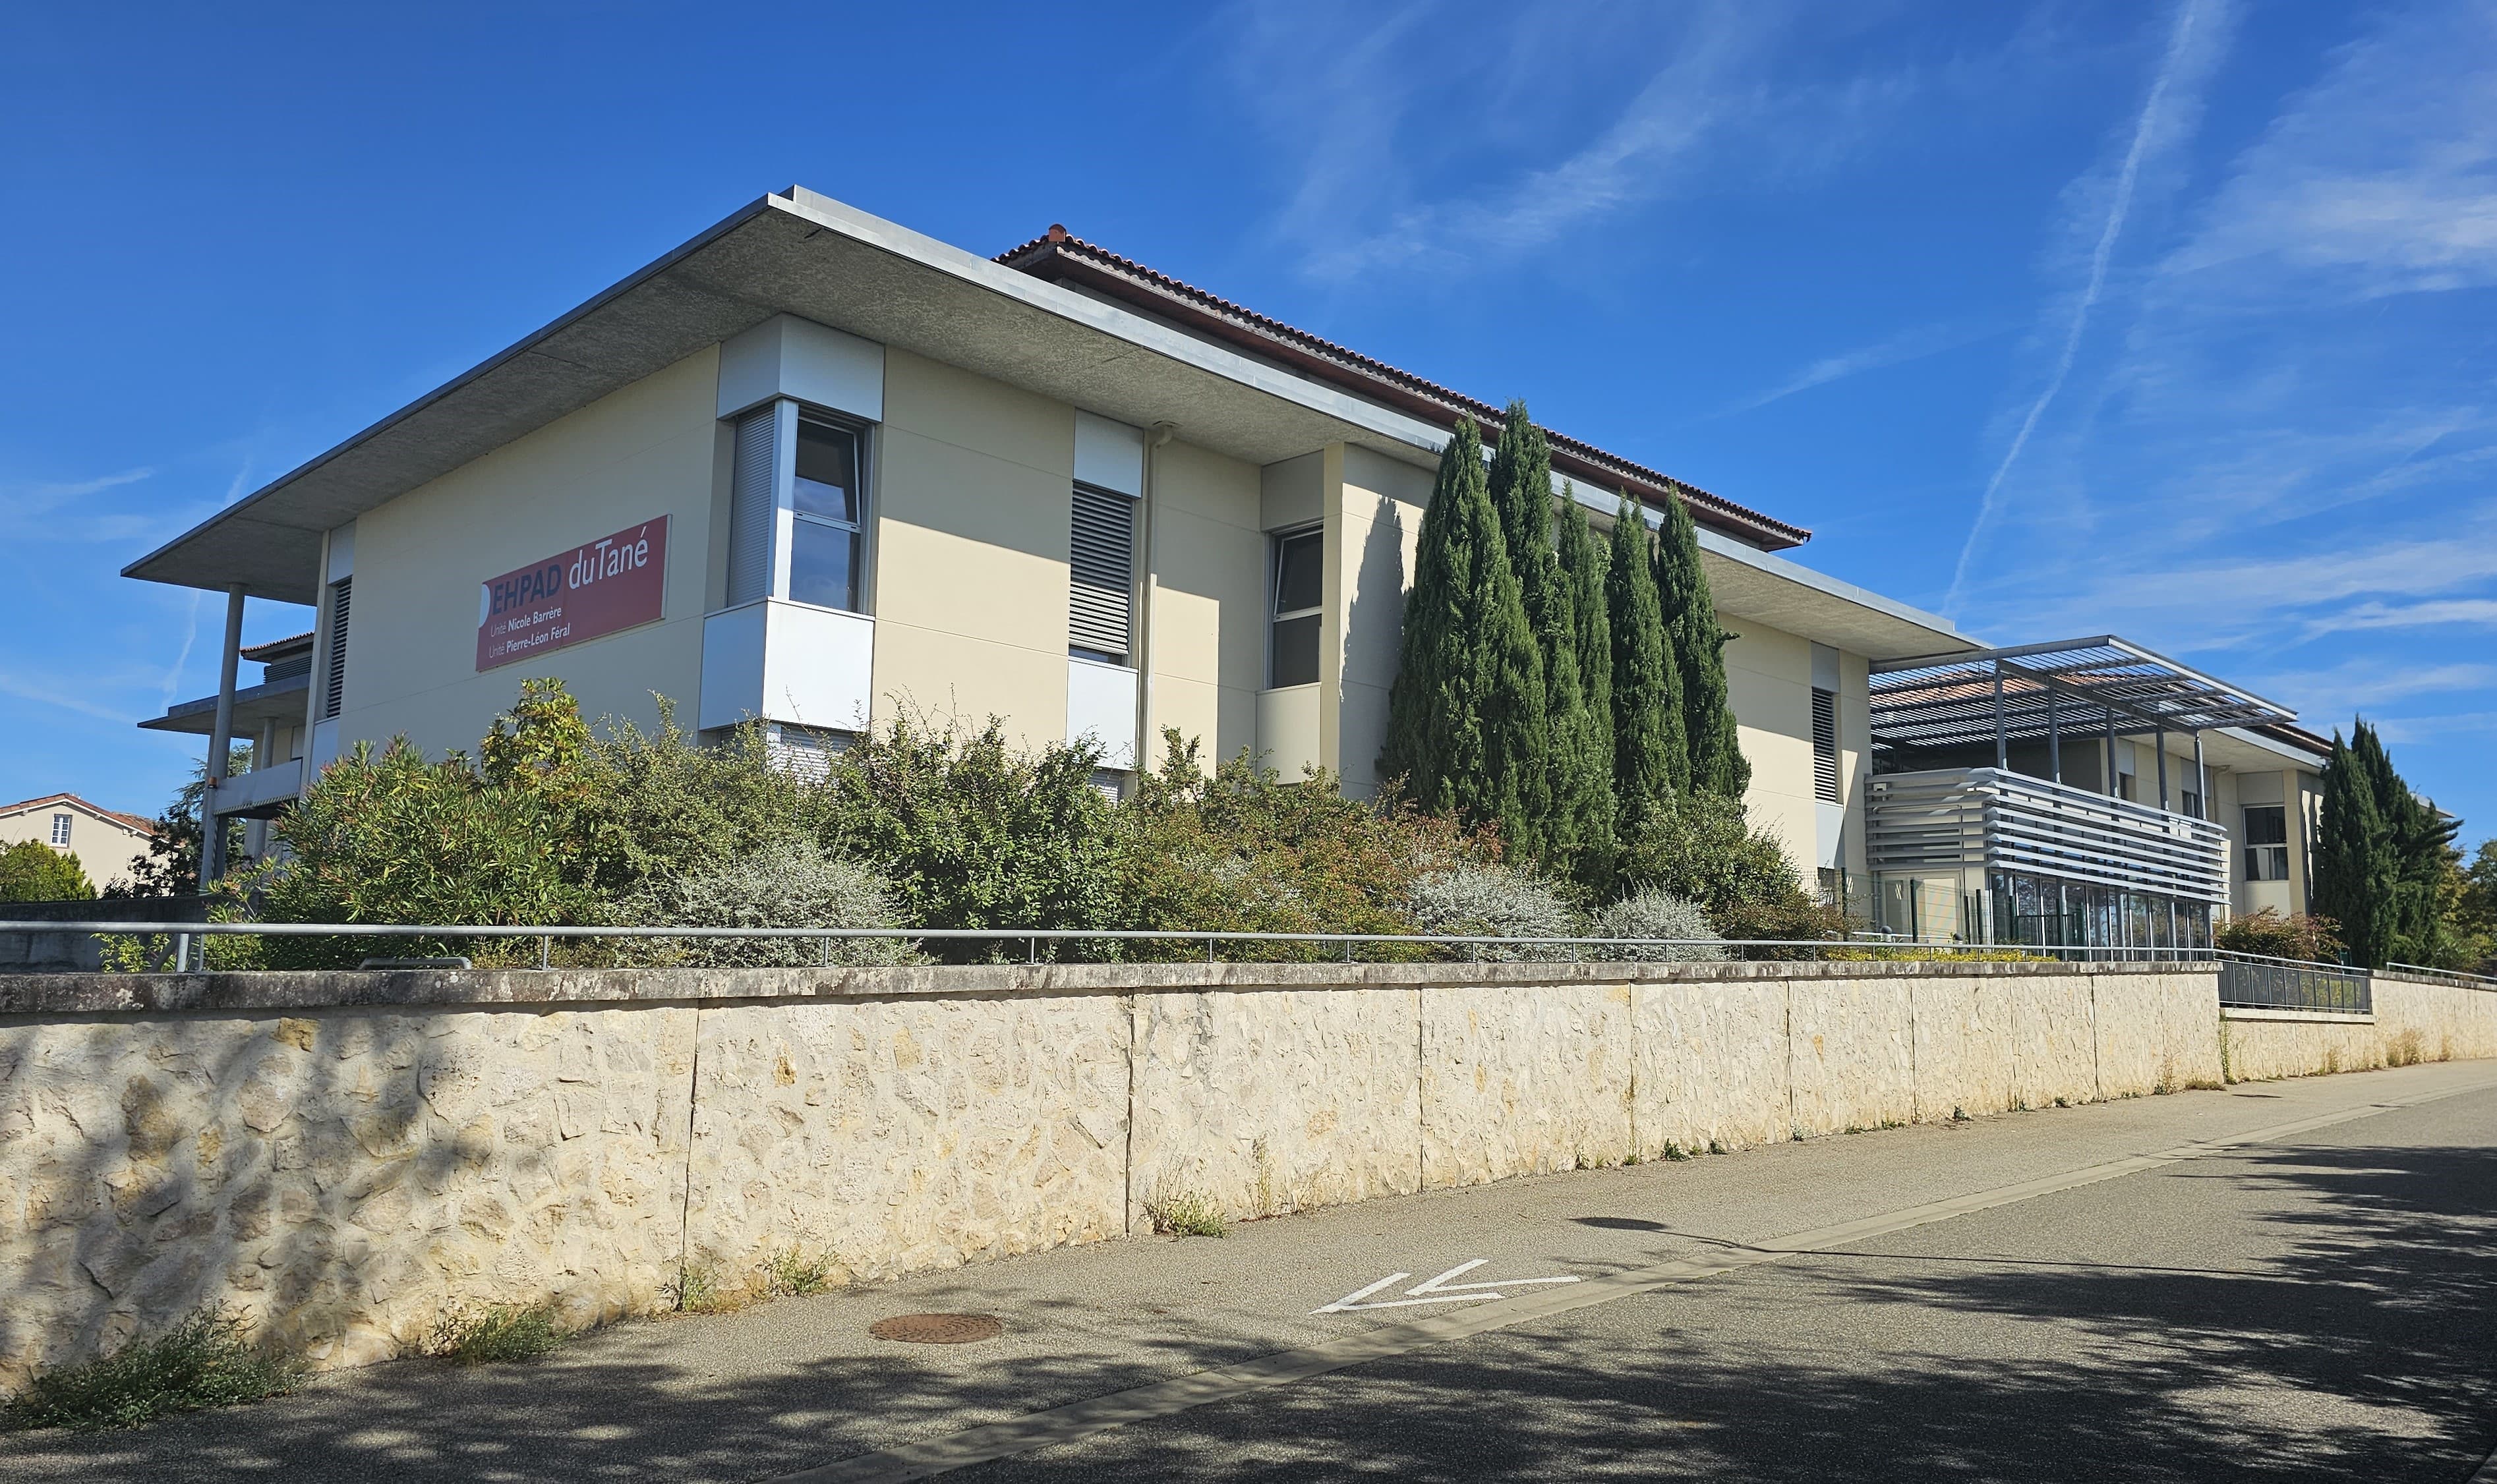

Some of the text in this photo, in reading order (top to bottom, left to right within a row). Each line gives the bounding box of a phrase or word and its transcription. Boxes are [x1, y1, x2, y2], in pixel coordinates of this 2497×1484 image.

[492, 564, 562, 615] EHPAD
[490, 606, 562, 637] Unité Nicole Barrère
[489, 623, 570, 658] Unité Pierre-Léon Féral
